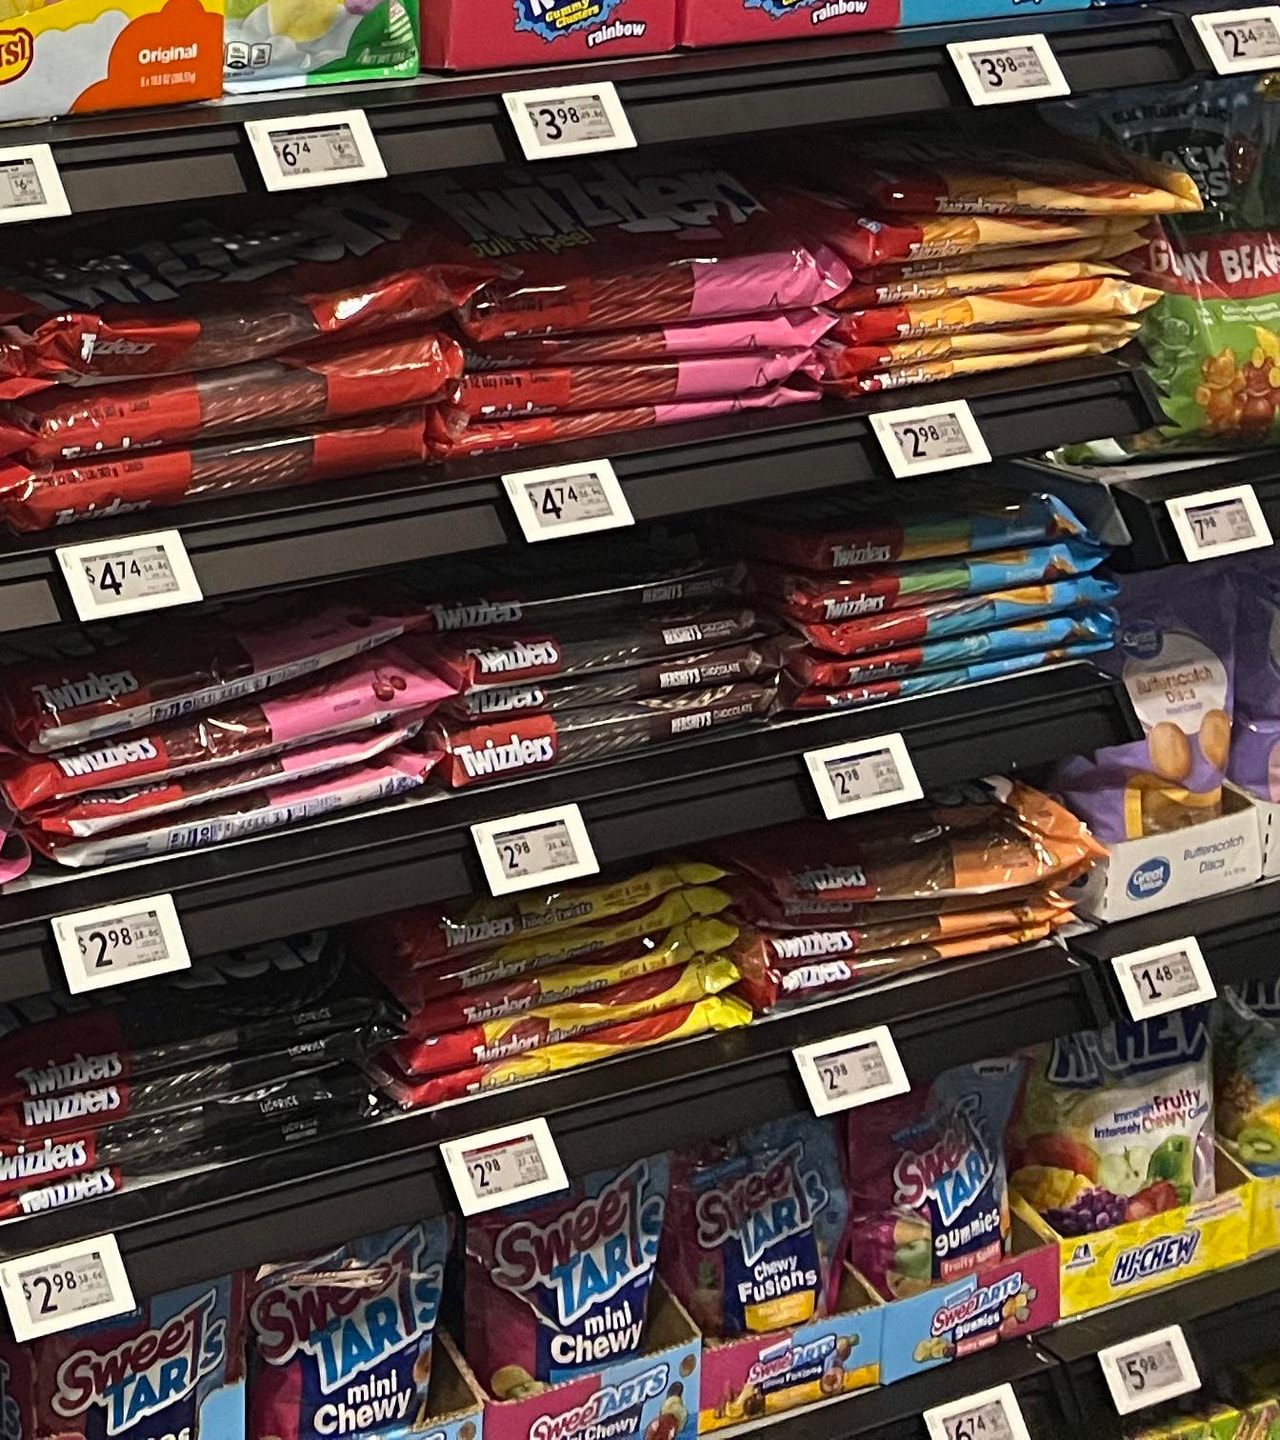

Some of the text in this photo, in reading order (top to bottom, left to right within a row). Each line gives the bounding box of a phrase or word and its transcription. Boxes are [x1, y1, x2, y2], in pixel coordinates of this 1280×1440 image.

[588, 20, 645, 47] rainbow
[671, 711, 711, 734] HERSHEY'S
[1184, 835, 1244, 860] Butterscotch
[1199, 859, 1224, 873] Discs
[1154, 1089, 1201, 1109] Fruity
[935, 1210, 1000, 1256] gummies
[739, 1267, 816, 1303] Fusions
[348, 1371, 398, 1404] mini
[314, 1387, 412, 1435] Chewy
